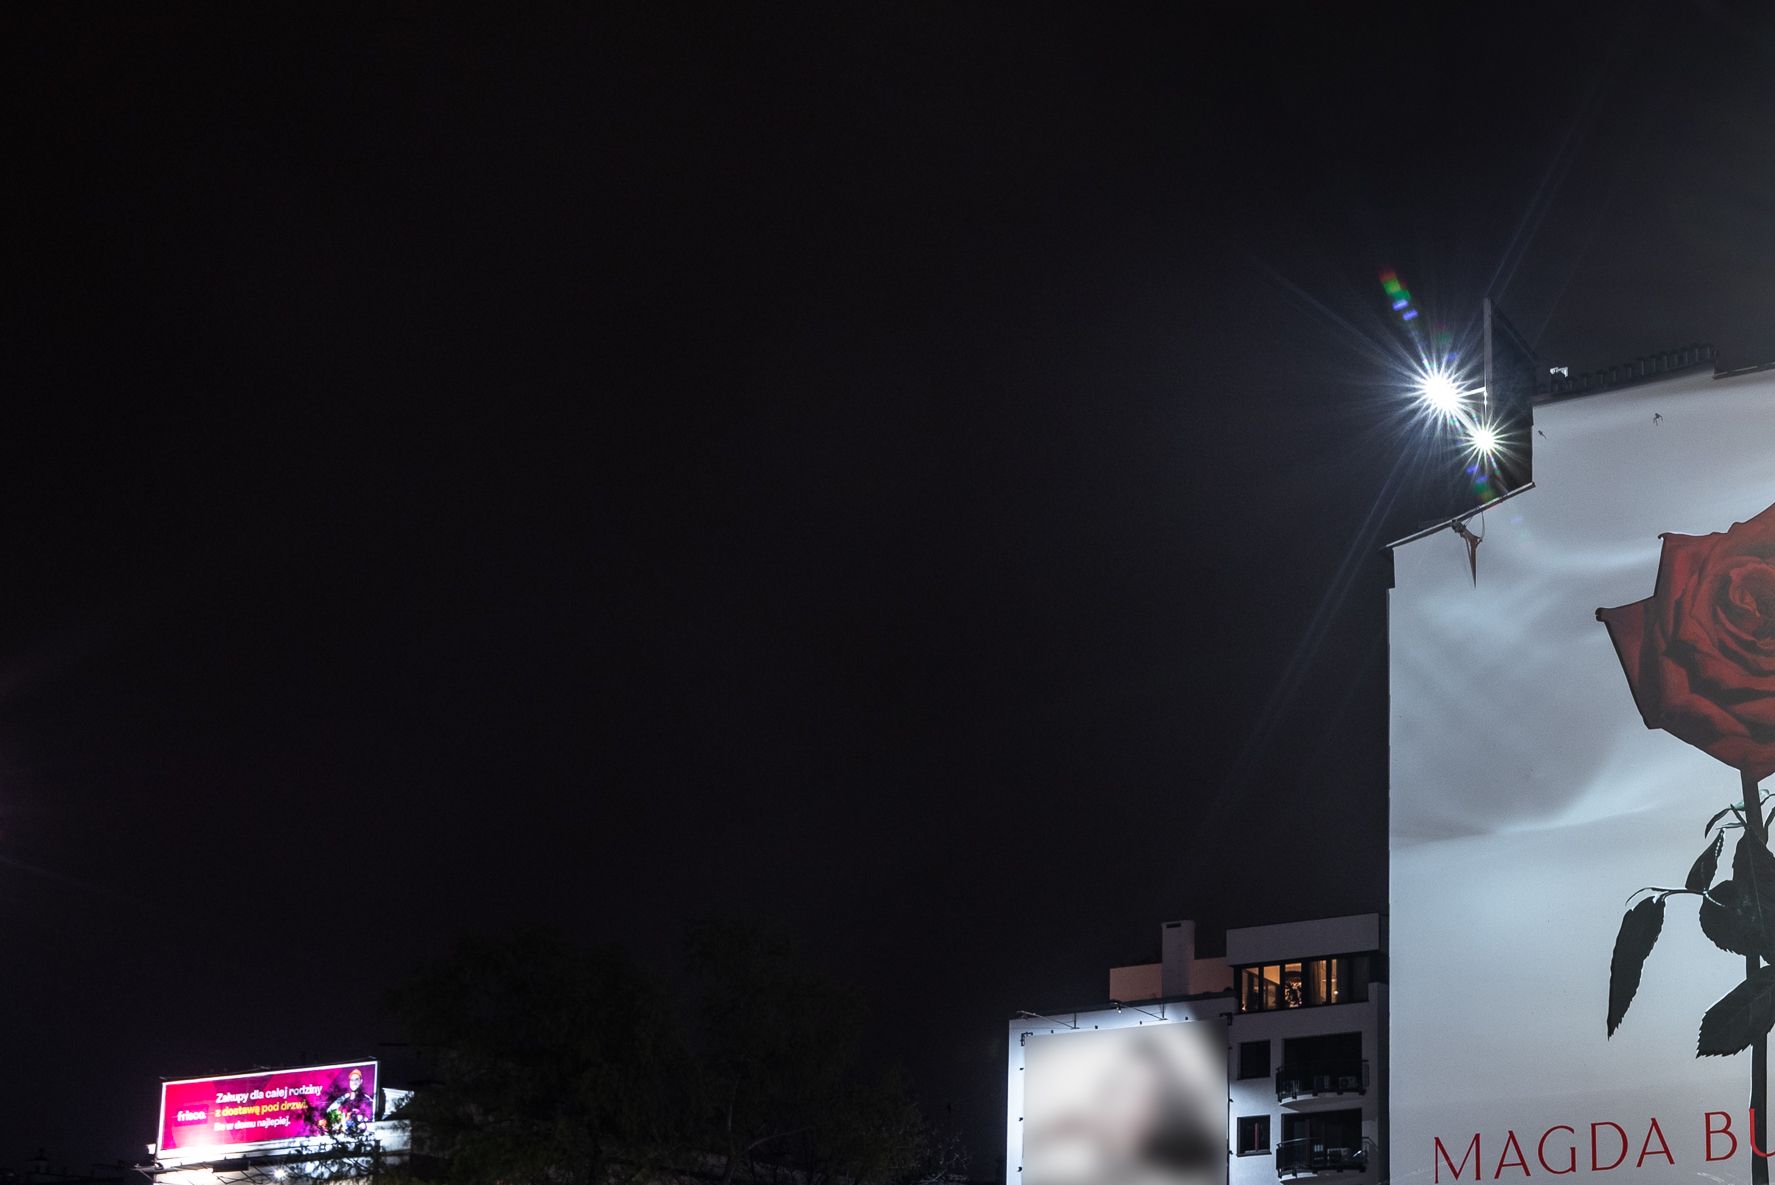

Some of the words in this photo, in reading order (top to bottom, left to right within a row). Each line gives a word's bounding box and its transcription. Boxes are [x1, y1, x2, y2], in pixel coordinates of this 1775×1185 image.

[216, 1091, 249, 1104] Zakupy
[250, 1089, 264, 1100] dla
[289, 1084, 323, 1098] rodziny
[215, 1109, 222, 1118] z
[261, 1101, 280, 1115] pod
[257, 1116, 291, 1129] najlepiej.
[1433, 1117, 1676, 1185] MAGDA
